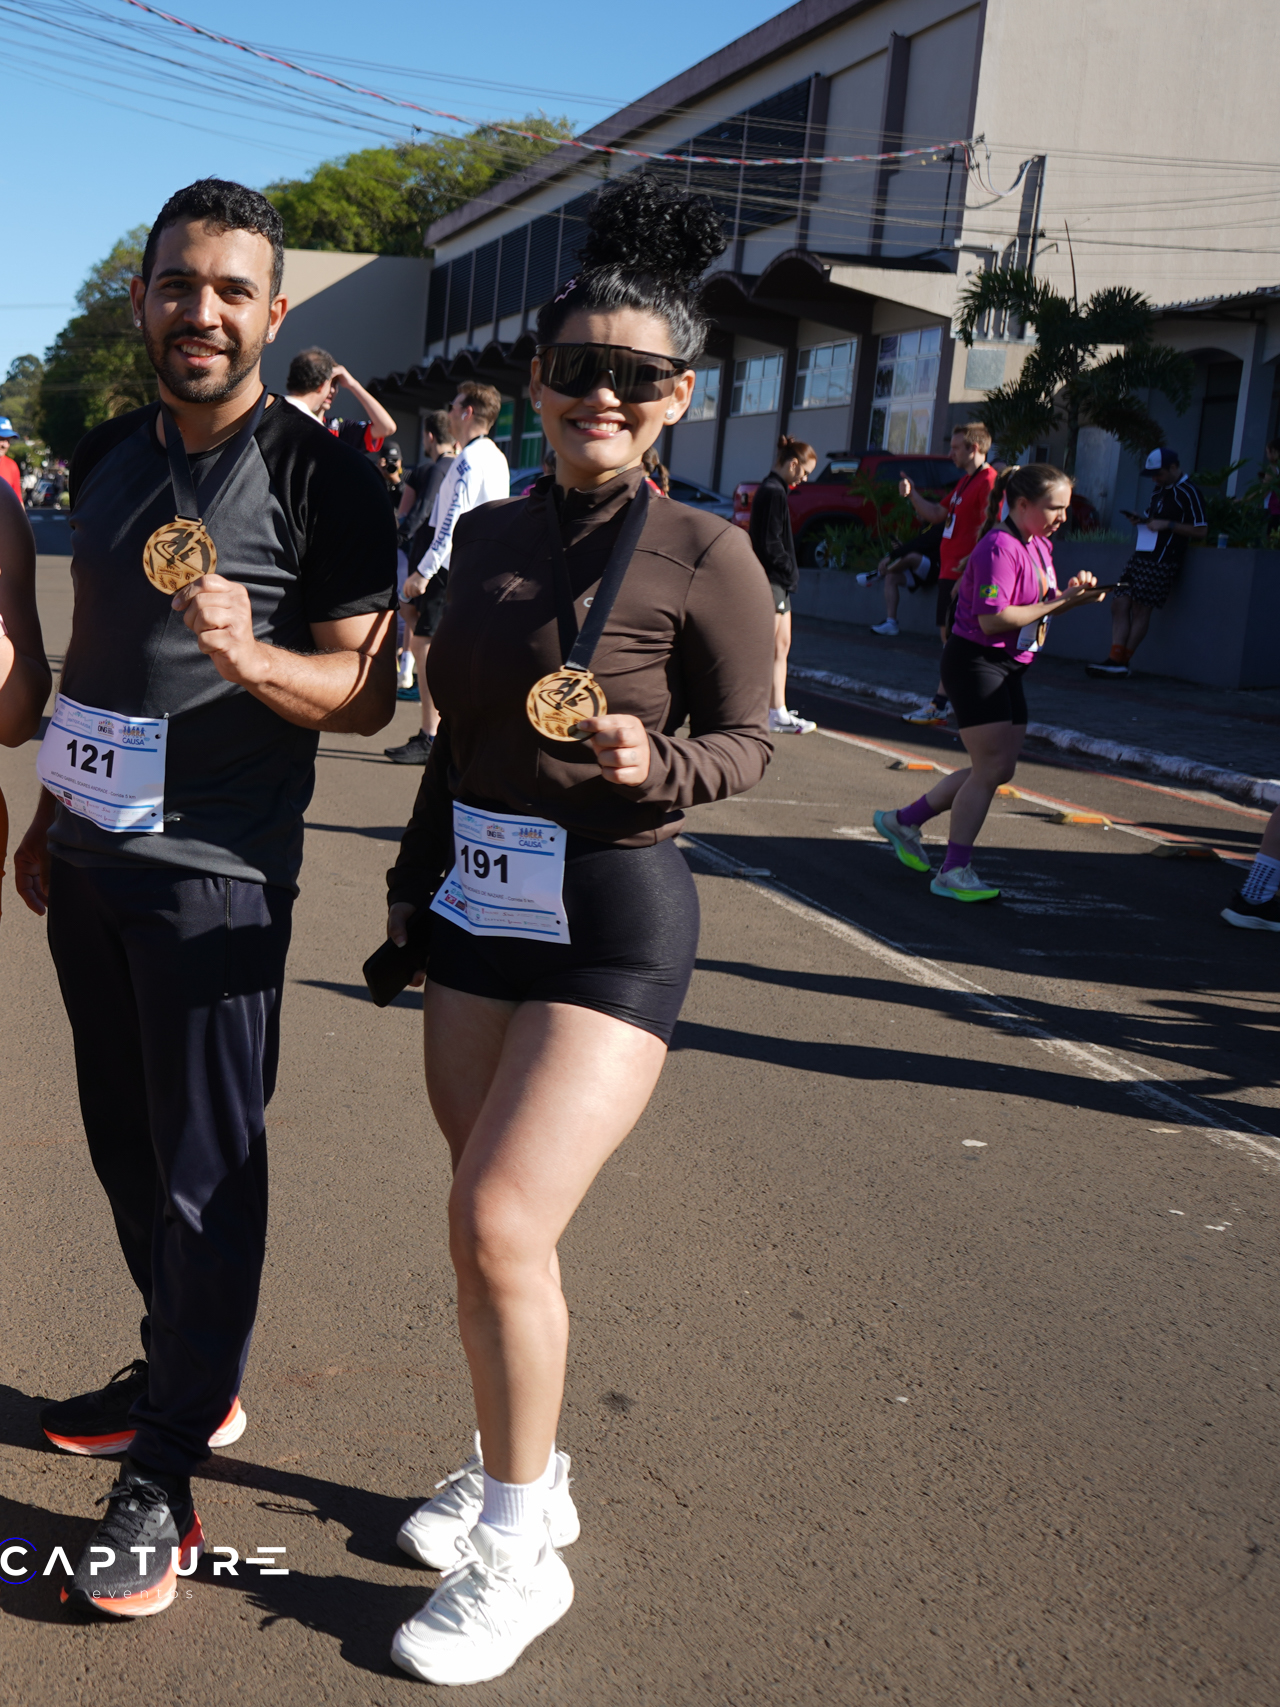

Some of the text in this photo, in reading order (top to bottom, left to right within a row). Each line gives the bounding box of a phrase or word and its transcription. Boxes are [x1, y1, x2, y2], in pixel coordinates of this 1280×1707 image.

[431, 478, 468, 551] Columbia
[66, 739, 115, 779] 121
[122, 738, 145, 746] CAUSA
[460, 844, 508, 884] 191
[518, 840, 543, 849] CAUSA
